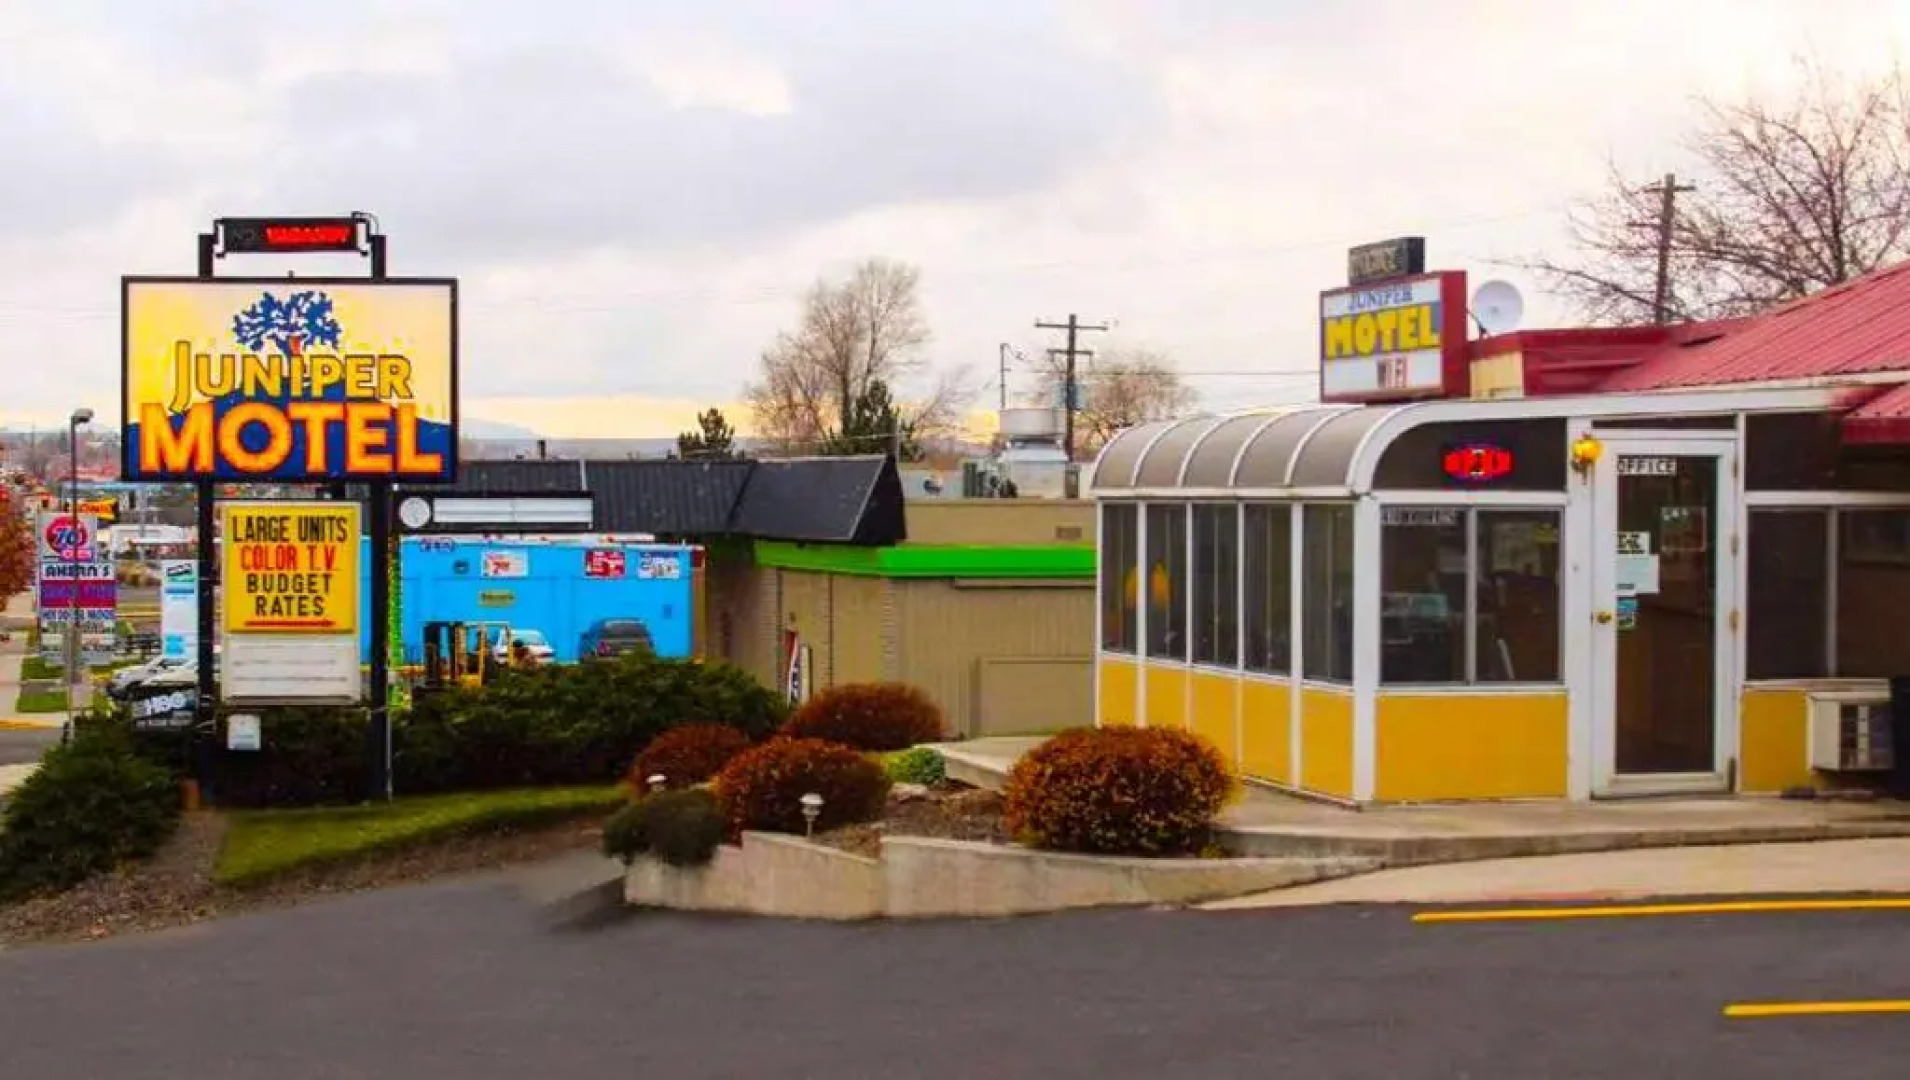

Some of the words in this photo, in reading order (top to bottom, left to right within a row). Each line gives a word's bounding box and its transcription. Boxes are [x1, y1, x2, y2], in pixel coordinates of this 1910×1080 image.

[1347, 283, 1413, 312] JUNIPER
[1325, 303, 1440, 358] MOTEL
[138, 401, 445, 475] MOTEL
[1617, 458, 1676, 475] OFFICE
[232, 515, 291, 543] LARGE
[298, 515, 348, 543] UNITS
[241, 544, 298, 571] COLOR
[246, 573, 333, 594] BUDGET
[255, 595, 325, 616] RATES
